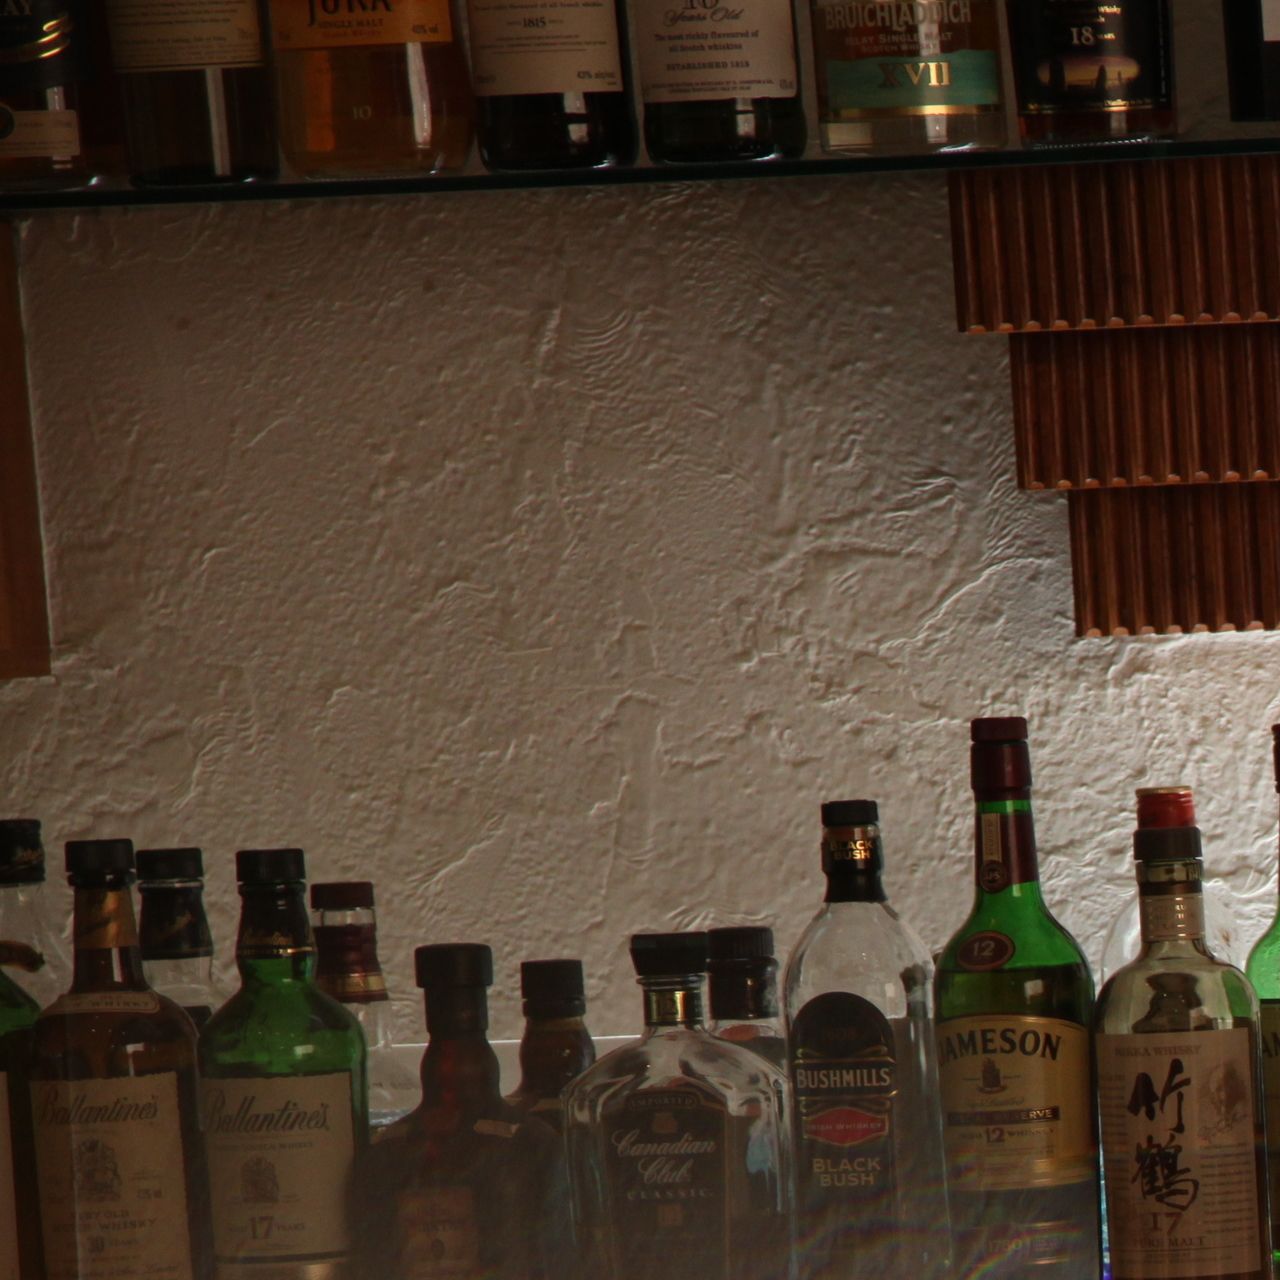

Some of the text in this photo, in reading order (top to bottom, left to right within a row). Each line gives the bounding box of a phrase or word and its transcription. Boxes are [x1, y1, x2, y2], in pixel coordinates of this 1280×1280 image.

[823, 0, 972, 31] BRUICHLADDICH
[711, 30, 749, 39] flavoured
[879, 31, 919, 45] SINGLE
[1069, 25, 1095, 46] 18
[878, 61, 951, 89] XVII
[351, 105, 373, 120] 10
[829, 840, 874, 851] BLACK
[833, 850, 872, 861] BUSH
[973, 940, 996, 958] 12
[939, 1027, 1063, 1067] JAMESON
[796, 1066, 893, 1090] BUSHMILLS
[37, 1082, 160, 1127] Ballantine's
[204, 1087, 332, 1135] Ballantine's
[611, 1127, 717, 1158] Canadian
[986, 1127, 1005, 1144] 12
[637, 1156, 693, 1186] Club
[812, 1157, 882, 1174] BLACK
[819, 1173, 875, 1188] BUSH
[249, 1215, 274, 1240] 17
[1151, 1212, 1183, 1237] 17
